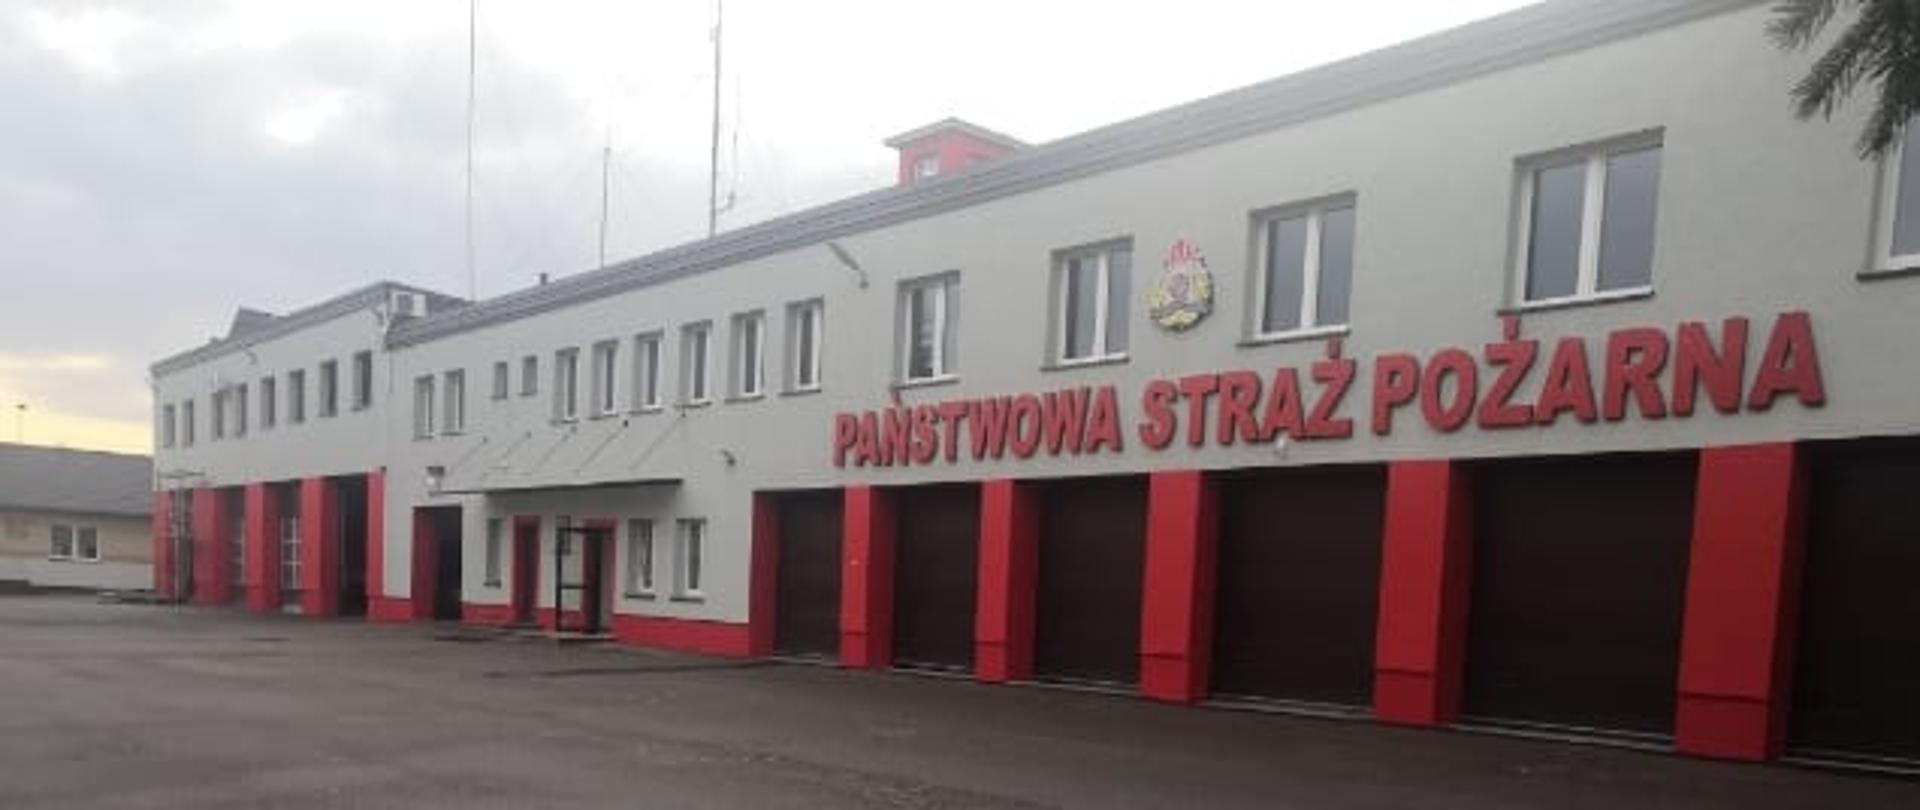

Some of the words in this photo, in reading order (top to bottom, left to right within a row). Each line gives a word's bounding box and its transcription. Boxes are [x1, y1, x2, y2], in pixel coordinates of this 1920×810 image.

[833, 386, 1123, 468] PAŃSTWOWA
[1139, 336, 1356, 449] STRAŻ
[1371, 310, 1826, 436] POŻARNA
